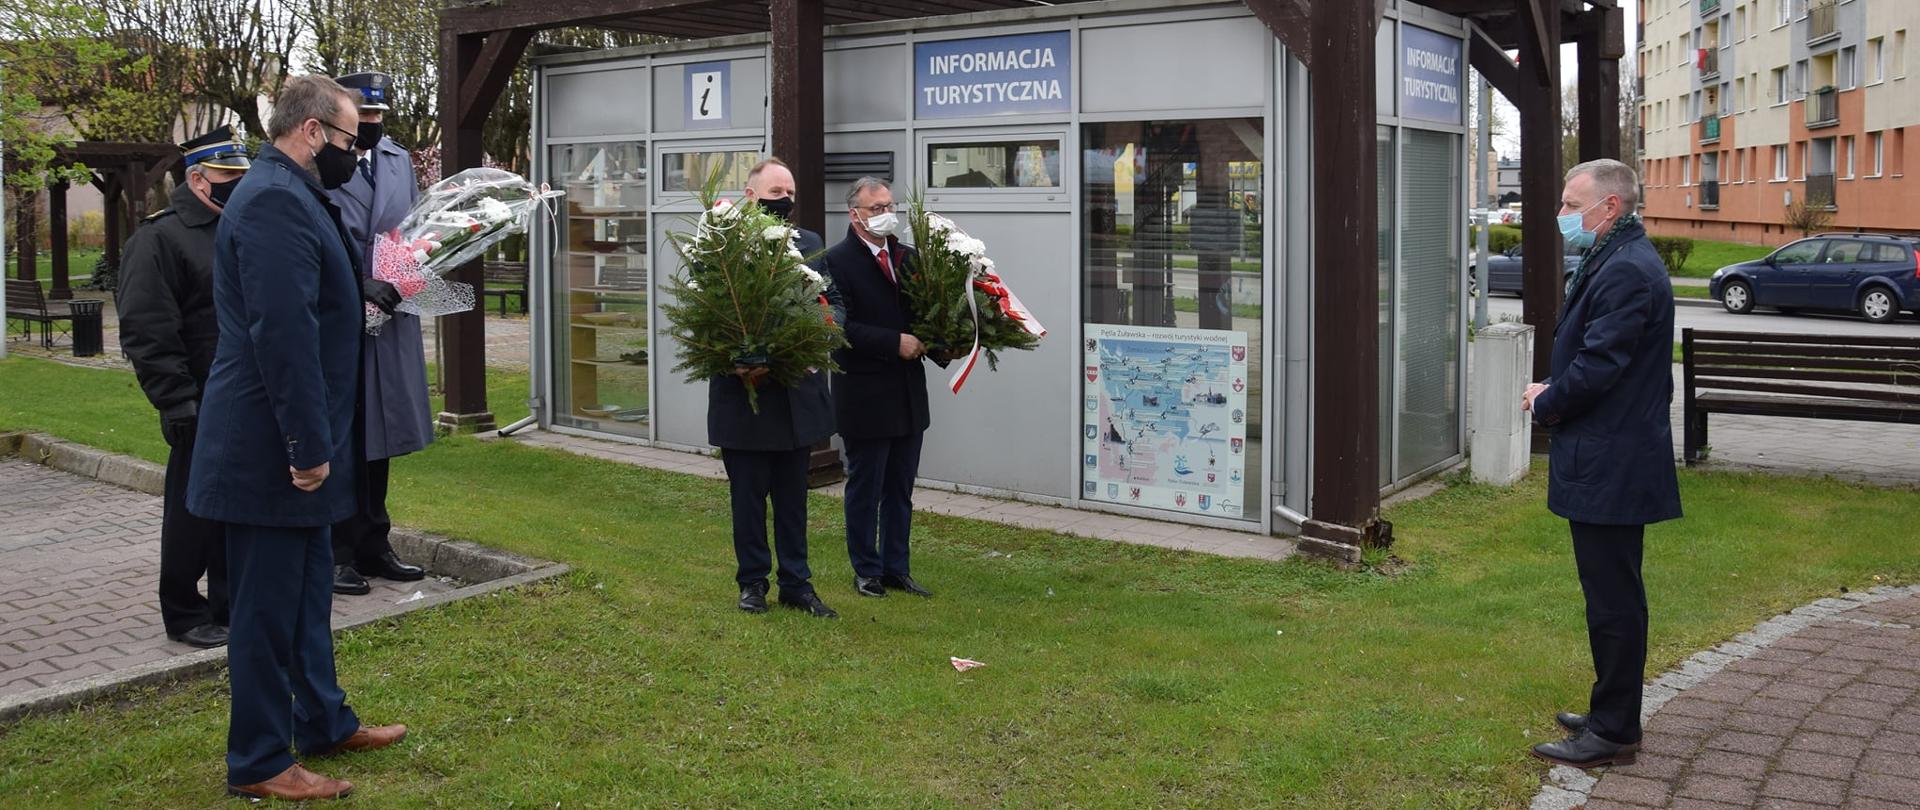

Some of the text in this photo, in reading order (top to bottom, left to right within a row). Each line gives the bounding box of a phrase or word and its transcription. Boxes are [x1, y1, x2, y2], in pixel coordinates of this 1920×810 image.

[929, 47, 1056, 76] INFORMACJA
[1407, 47, 1455, 76] INFORMACJA
[924, 79, 1062, 106] TURYSTYCZNA
[1404, 76, 1457, 105] TURYSTYCZNA
